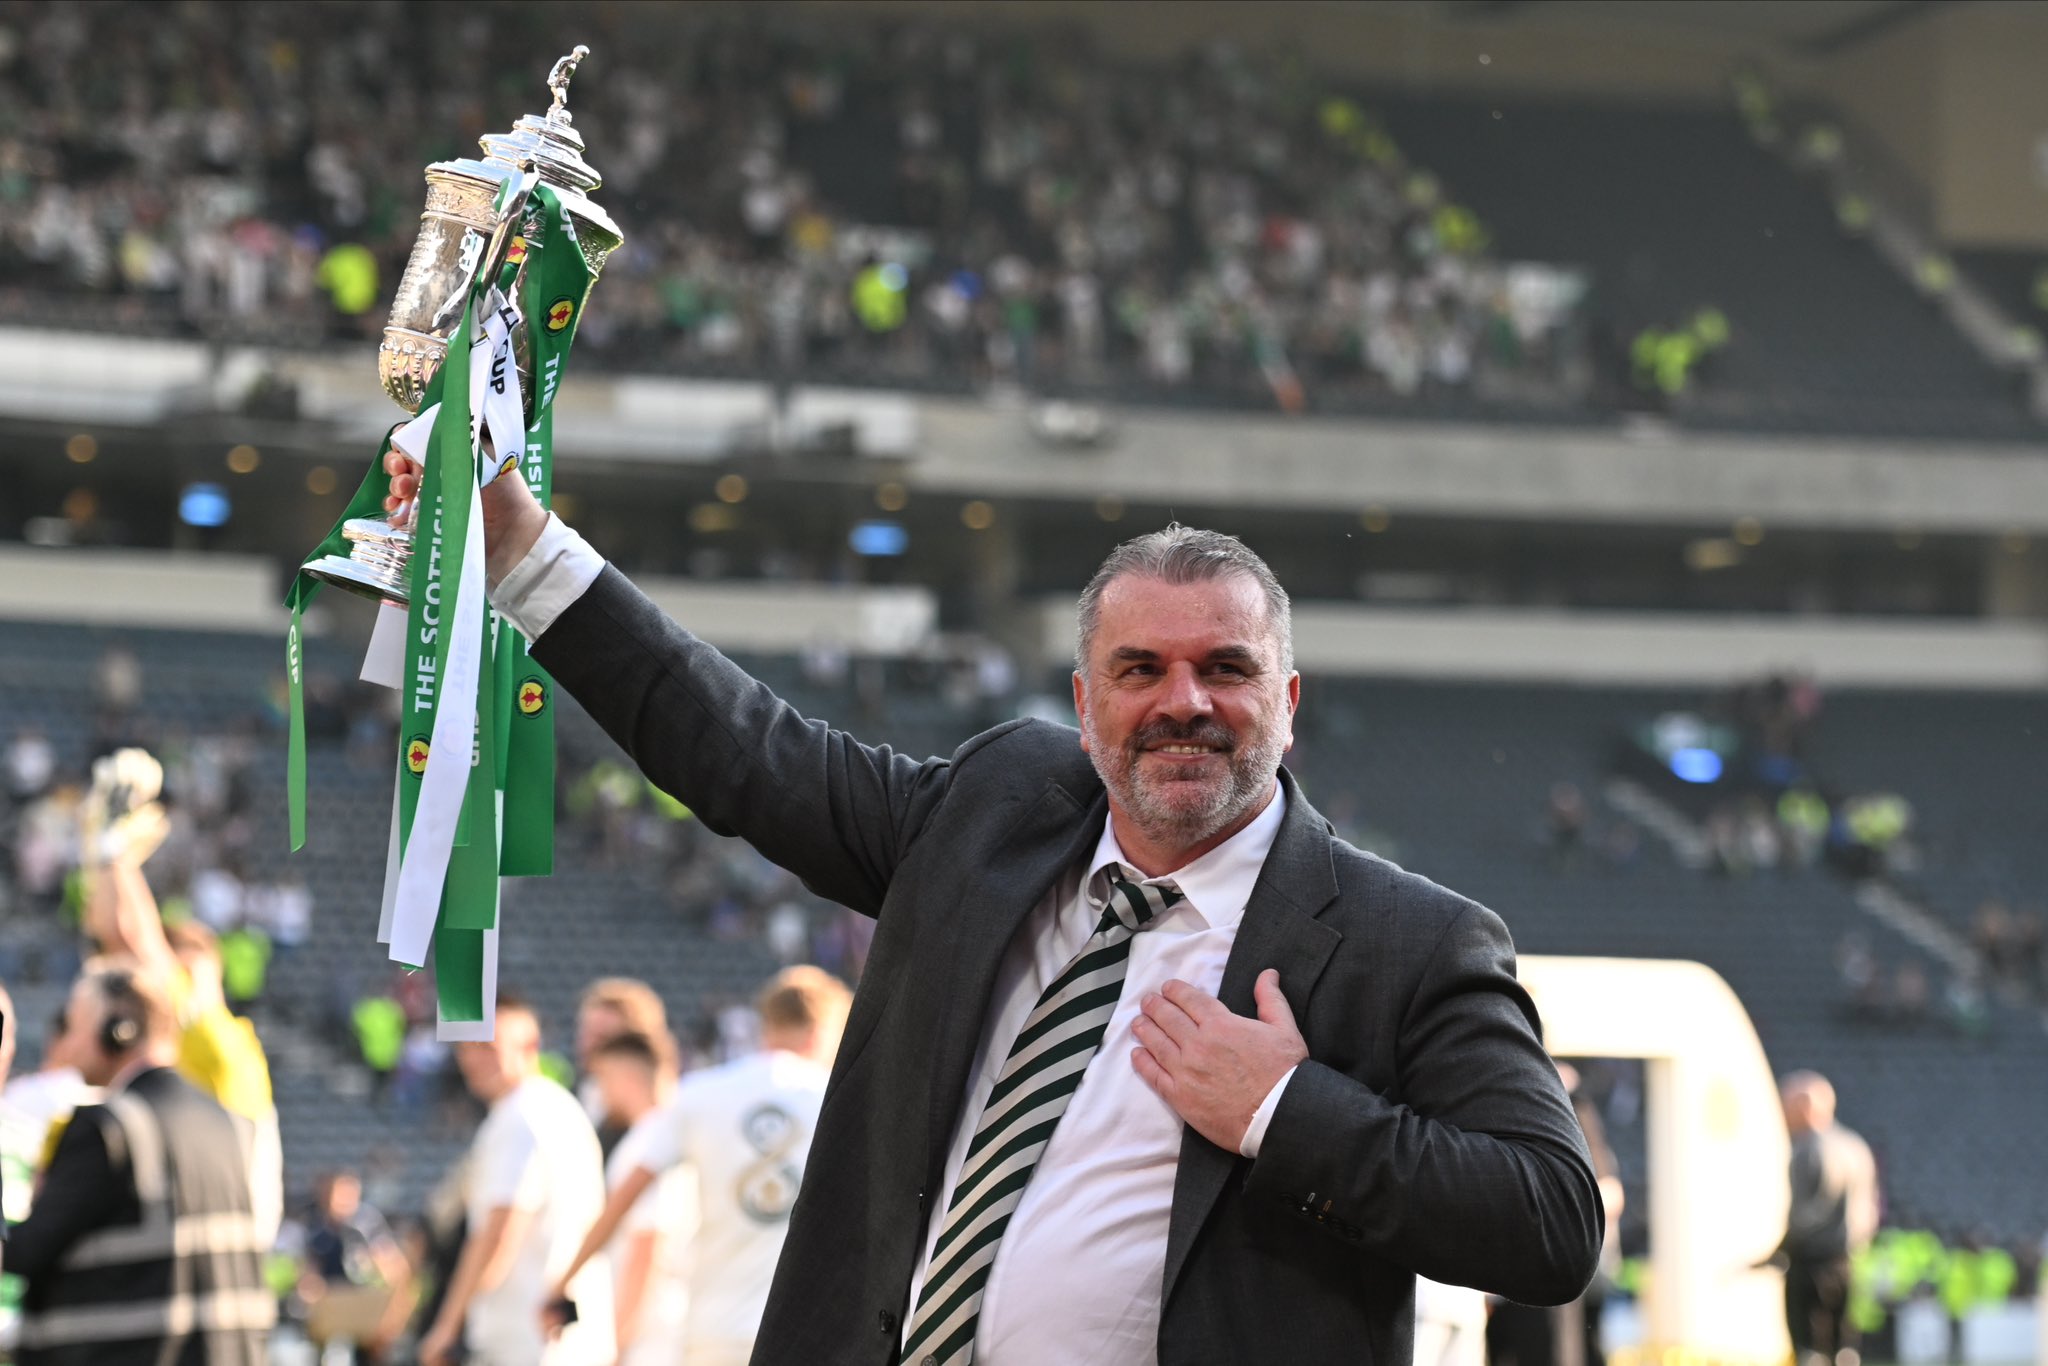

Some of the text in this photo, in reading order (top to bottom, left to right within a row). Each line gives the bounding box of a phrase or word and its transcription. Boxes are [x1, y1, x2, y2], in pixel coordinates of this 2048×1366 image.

[420, 495, 443, 645] SCOTTI
[289, 624, 299, 684] CUP
[414, 655, 437, 713] THE
